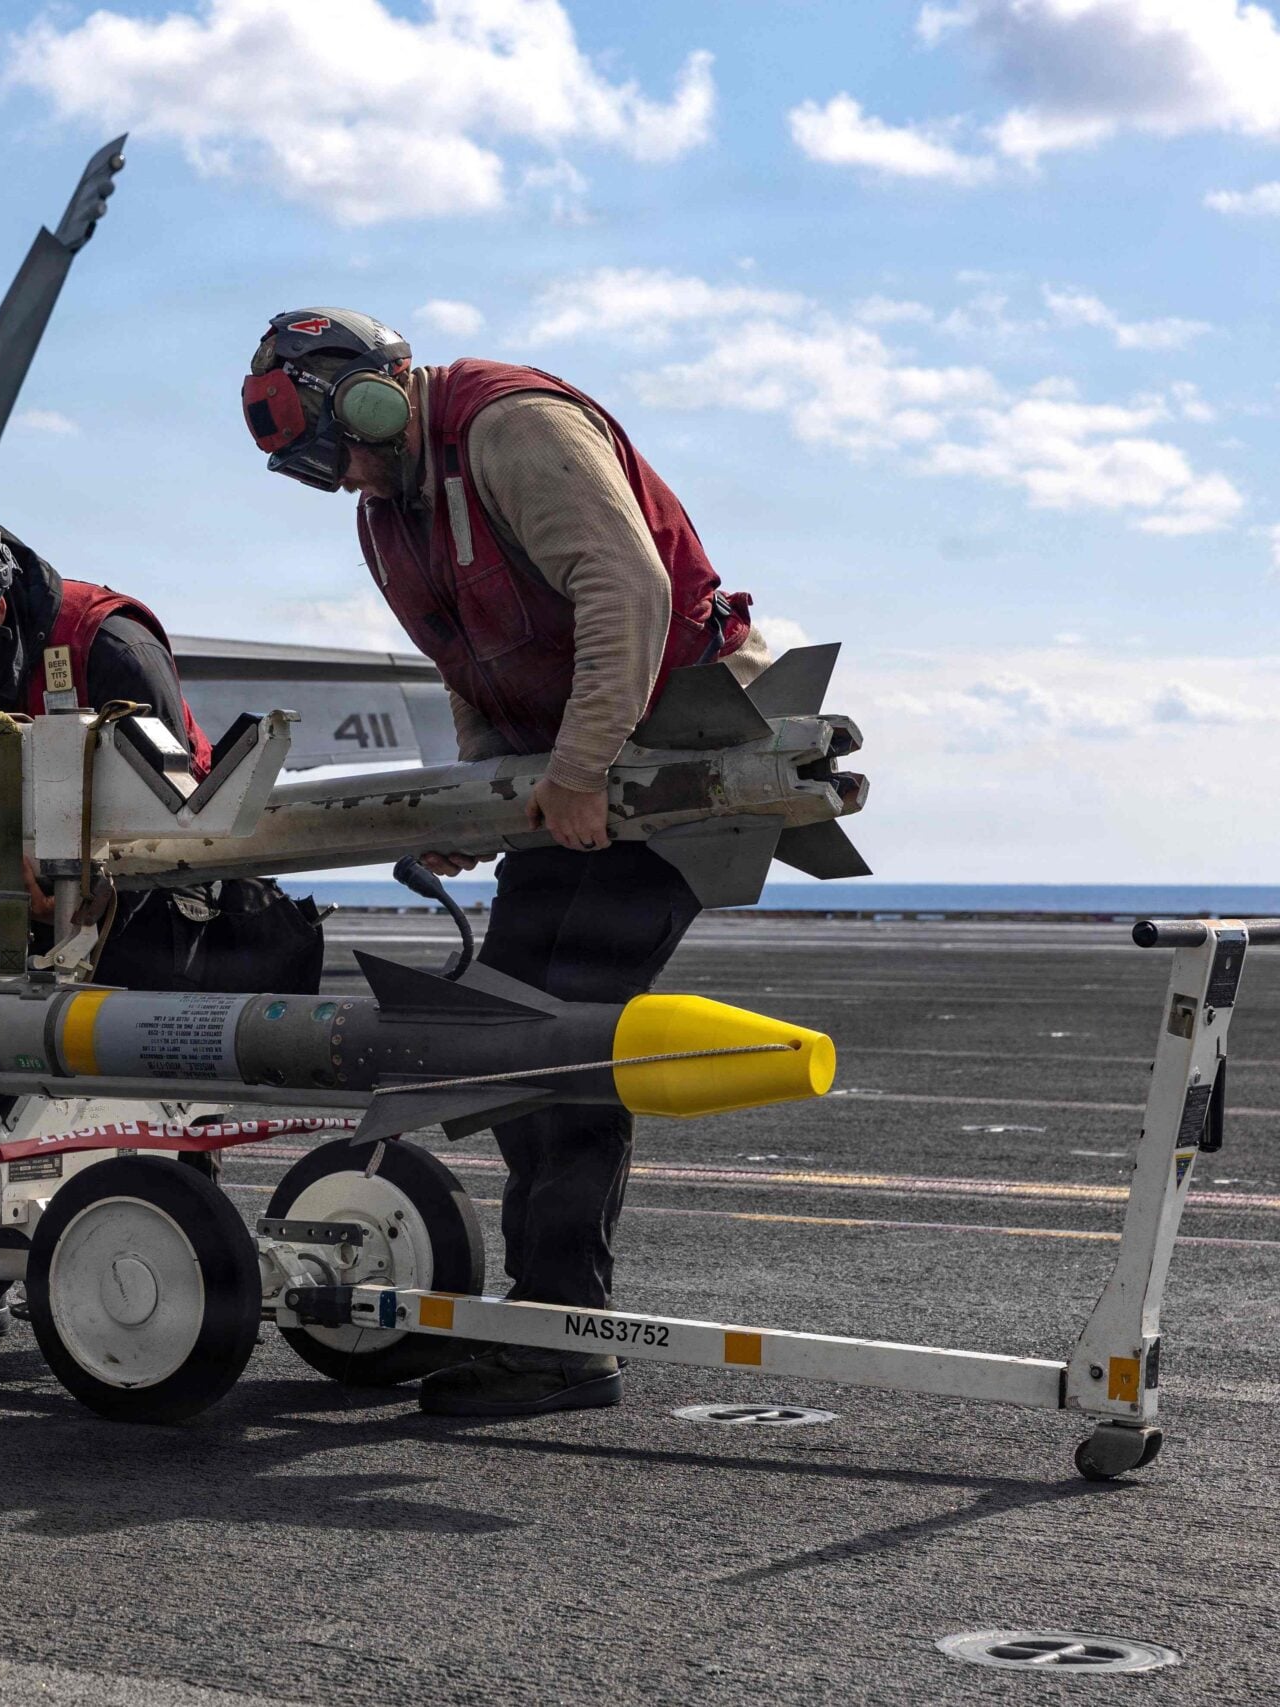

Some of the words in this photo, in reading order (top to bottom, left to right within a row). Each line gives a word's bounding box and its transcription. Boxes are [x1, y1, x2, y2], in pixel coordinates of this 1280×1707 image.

[48, 660, 67, 668] BEER
[51, 671, 67, 679] TITS
[334, 713, 398, 748] 411
[149, 1120, 258, 1137] BEFORE
[268, 1118, 362, 1133] EMOVE
[565, 1314, 670, 1347] NAS3752
